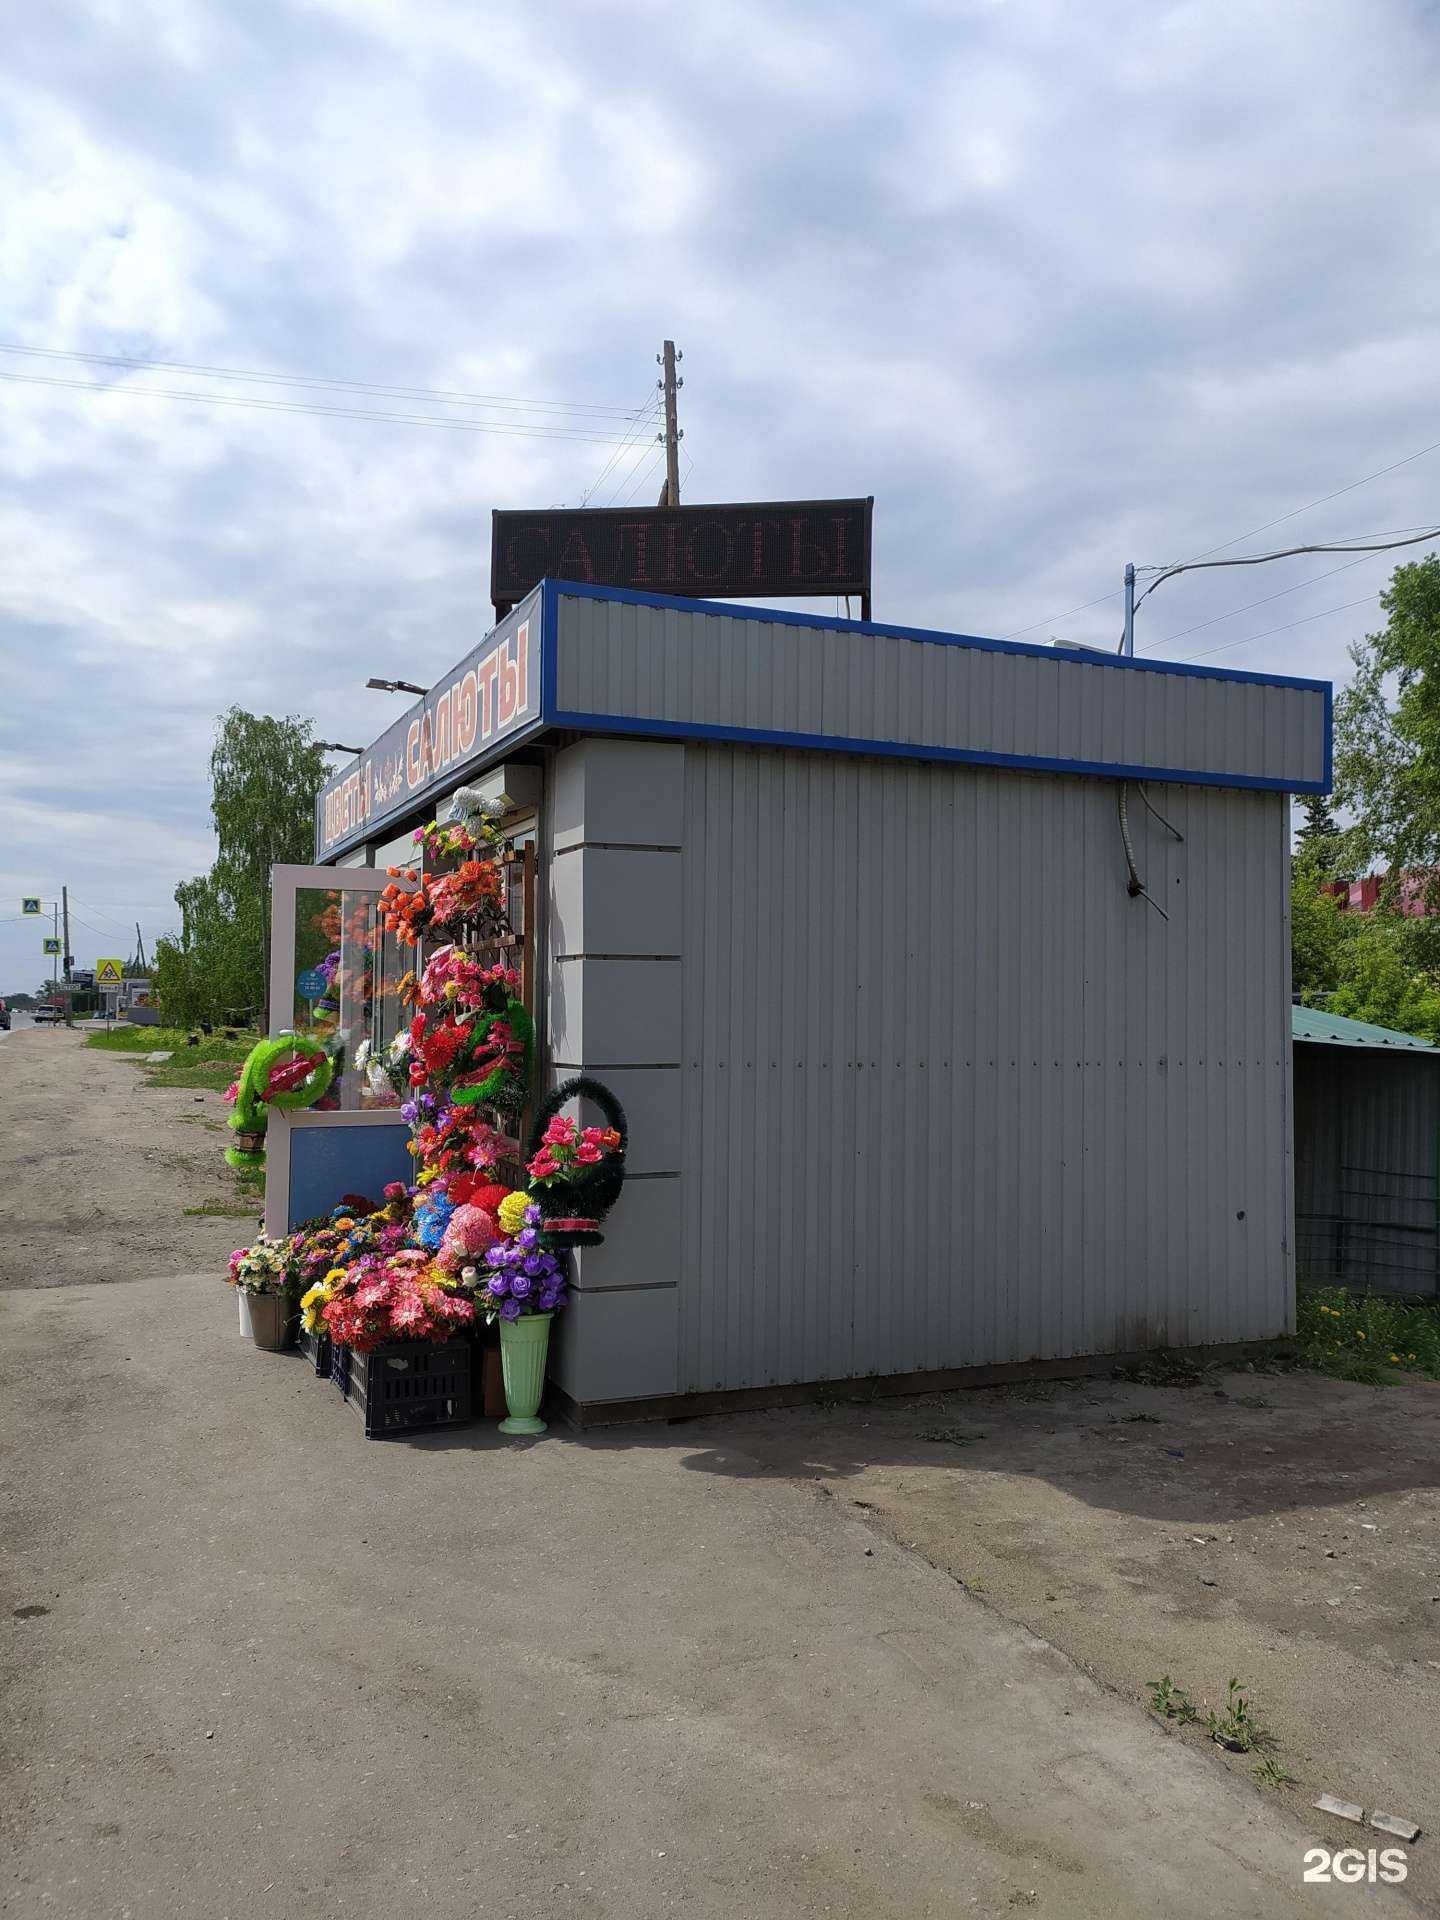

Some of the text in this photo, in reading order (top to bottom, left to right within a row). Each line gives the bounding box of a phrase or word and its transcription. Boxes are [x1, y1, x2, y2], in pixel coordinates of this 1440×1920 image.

[504, 517, 852, 583] САЛЮТЫ
[325, 621, 529, 847] ЦВЕТЫ САЛЮТЫ
